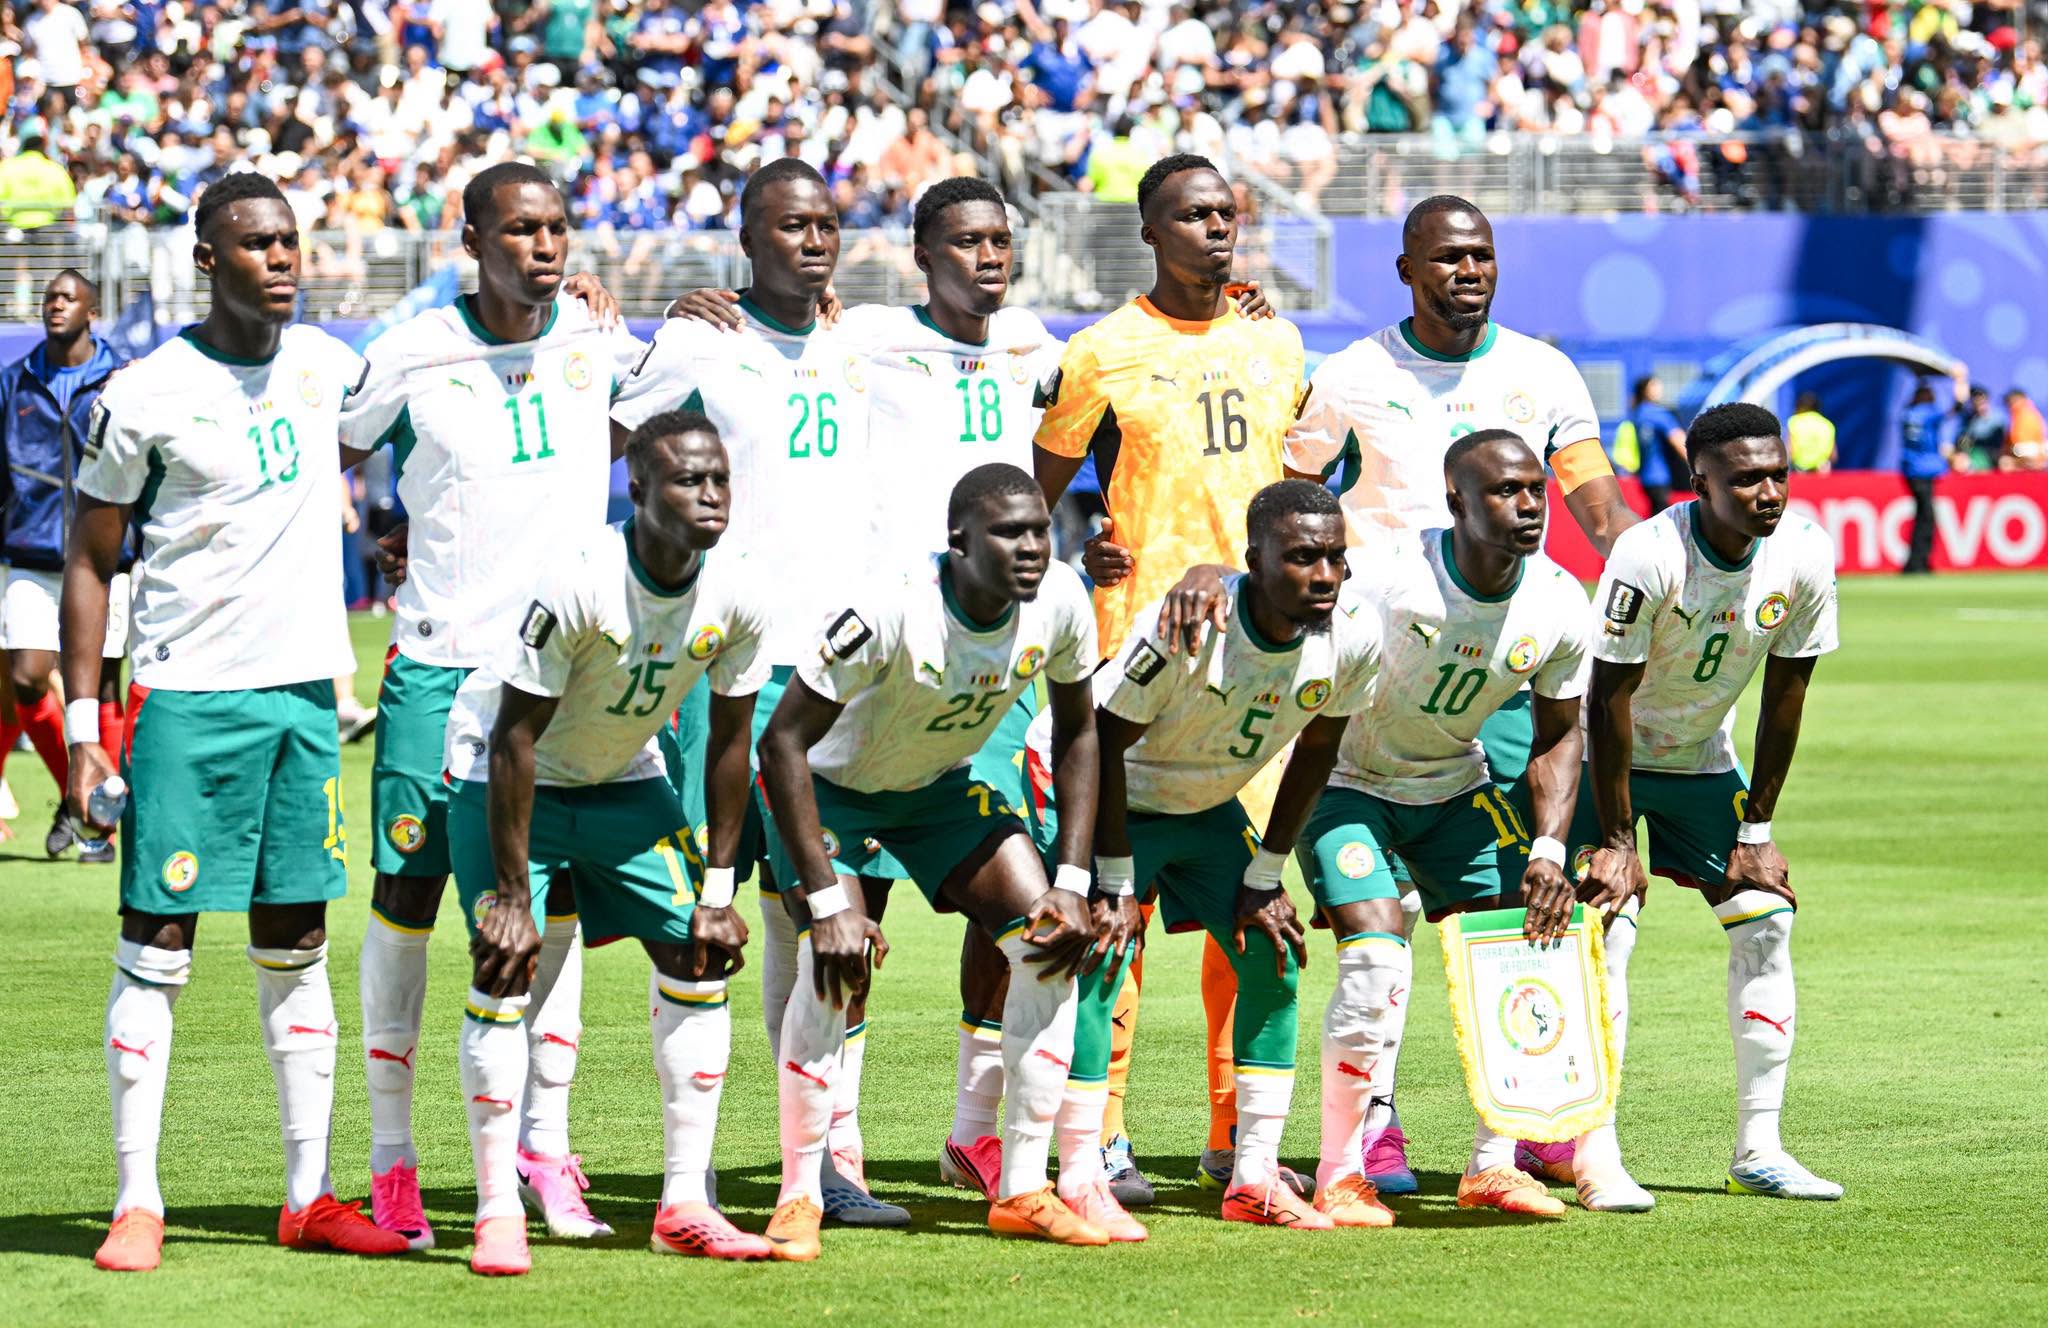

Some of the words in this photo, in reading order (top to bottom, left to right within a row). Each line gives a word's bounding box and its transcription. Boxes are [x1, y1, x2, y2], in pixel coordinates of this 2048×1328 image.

[503, 392, 556, 464] 11
[787, 391, 838, 458] 26
[955, 378, 1002, 442] 18
[1196, 388, 1247, 456] 16
[247, 416, 300, 489] 19
[1788, 494, 2047, 568] novo
[605, 660, 677, 717] 15
[1693, 632, 1730, 682] 8
[926, 689, 1006, 732] 25
[1419, 663, 1488, 716] 10
[1228, 708, 1275, 759] 5
